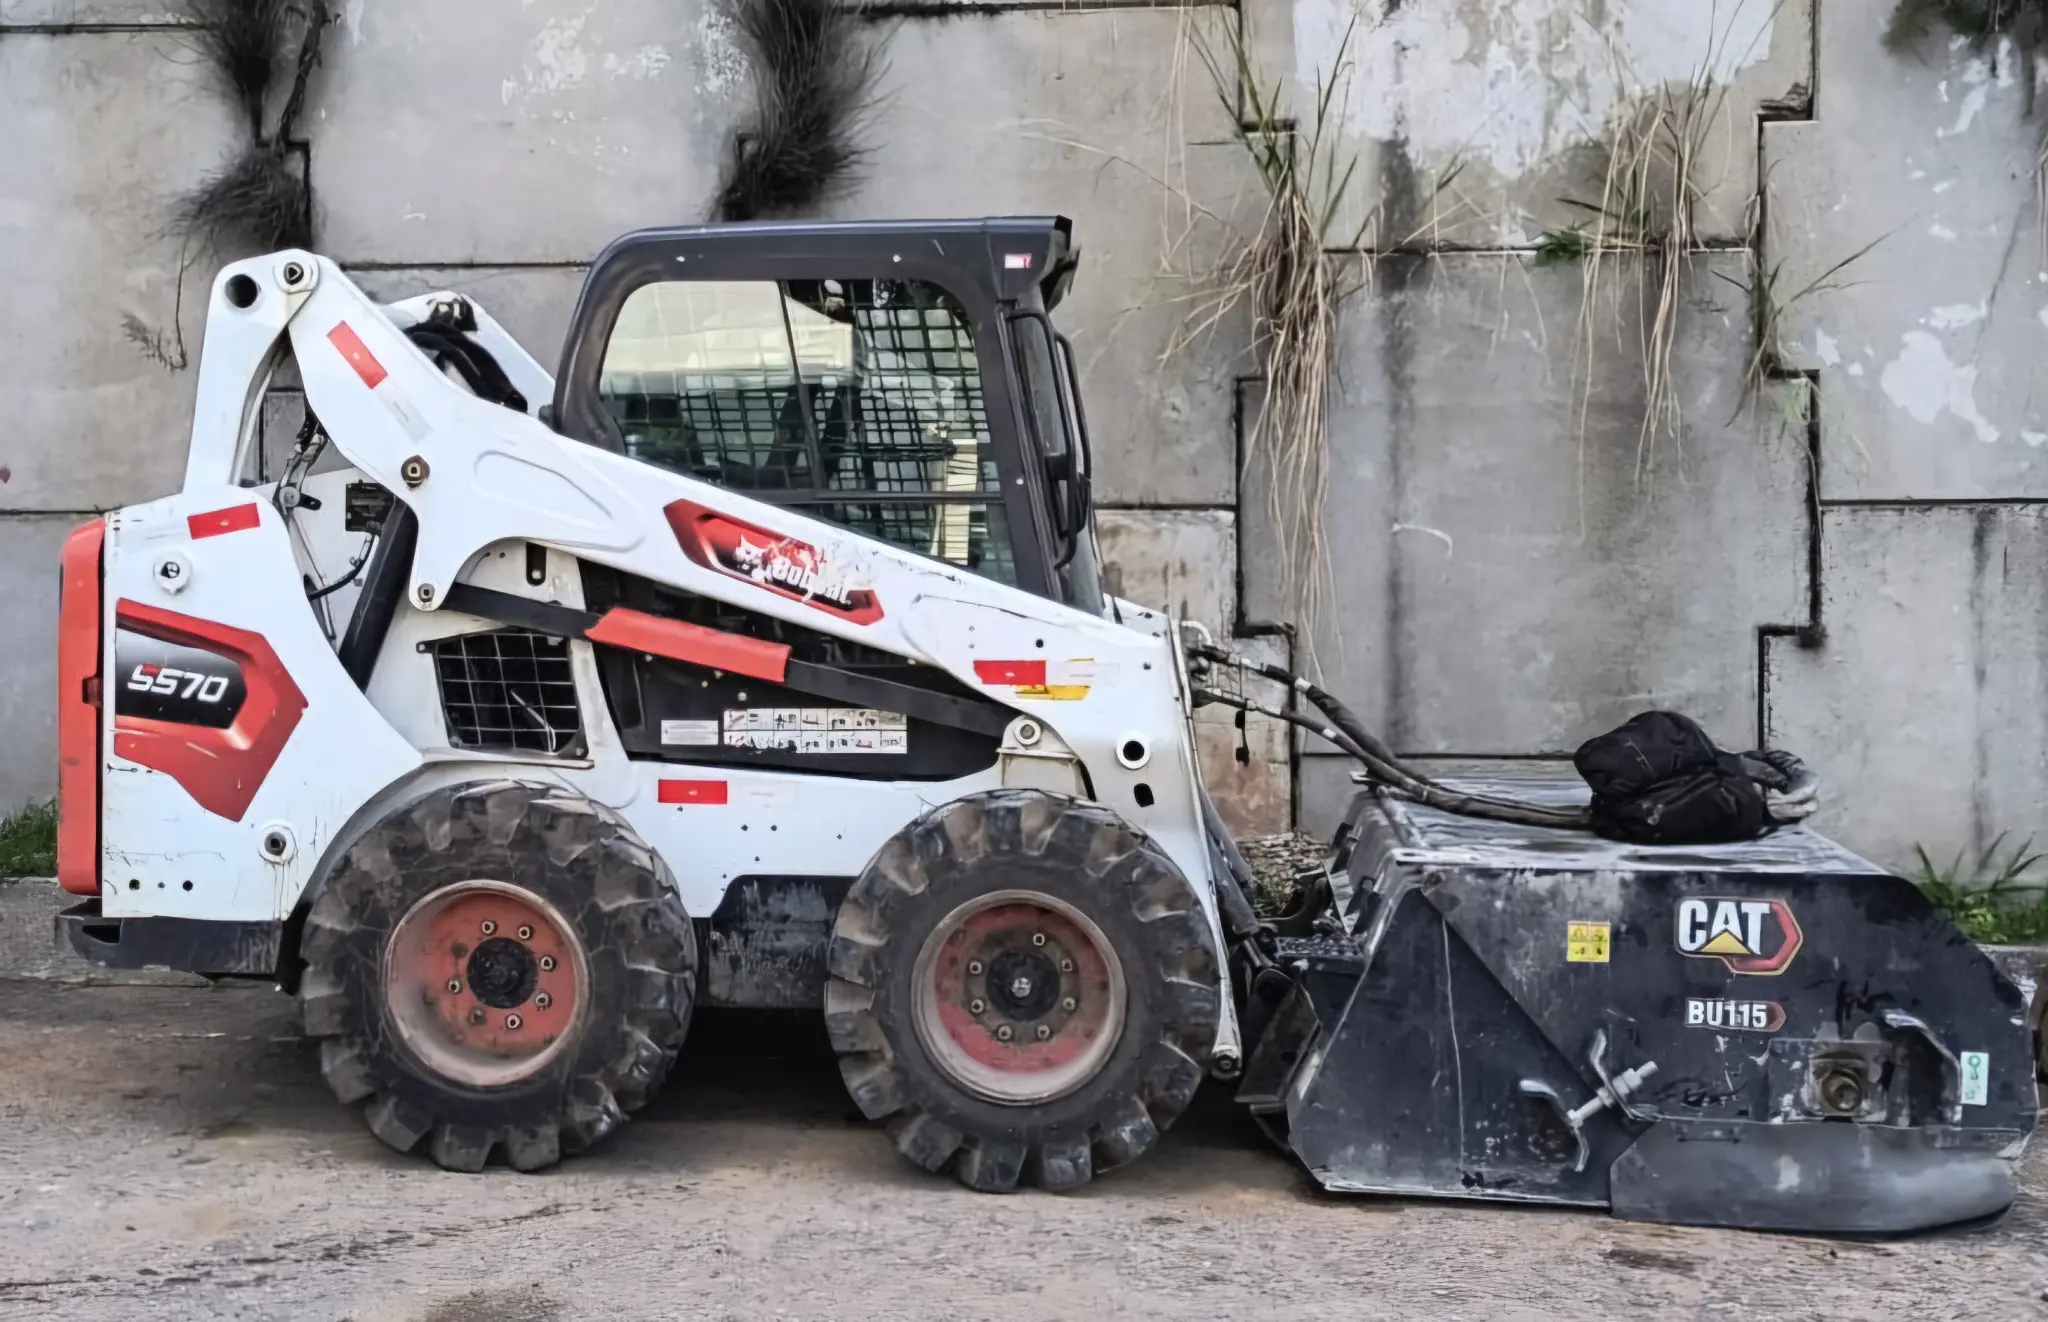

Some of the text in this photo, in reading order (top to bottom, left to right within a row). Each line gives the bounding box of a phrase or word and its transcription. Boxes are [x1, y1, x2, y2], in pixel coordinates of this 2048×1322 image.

[127, 663, 229, 702] S570
[1678, 900, 1771, 955] CAT
[1688, 1000, 1768, 1028] BU115
